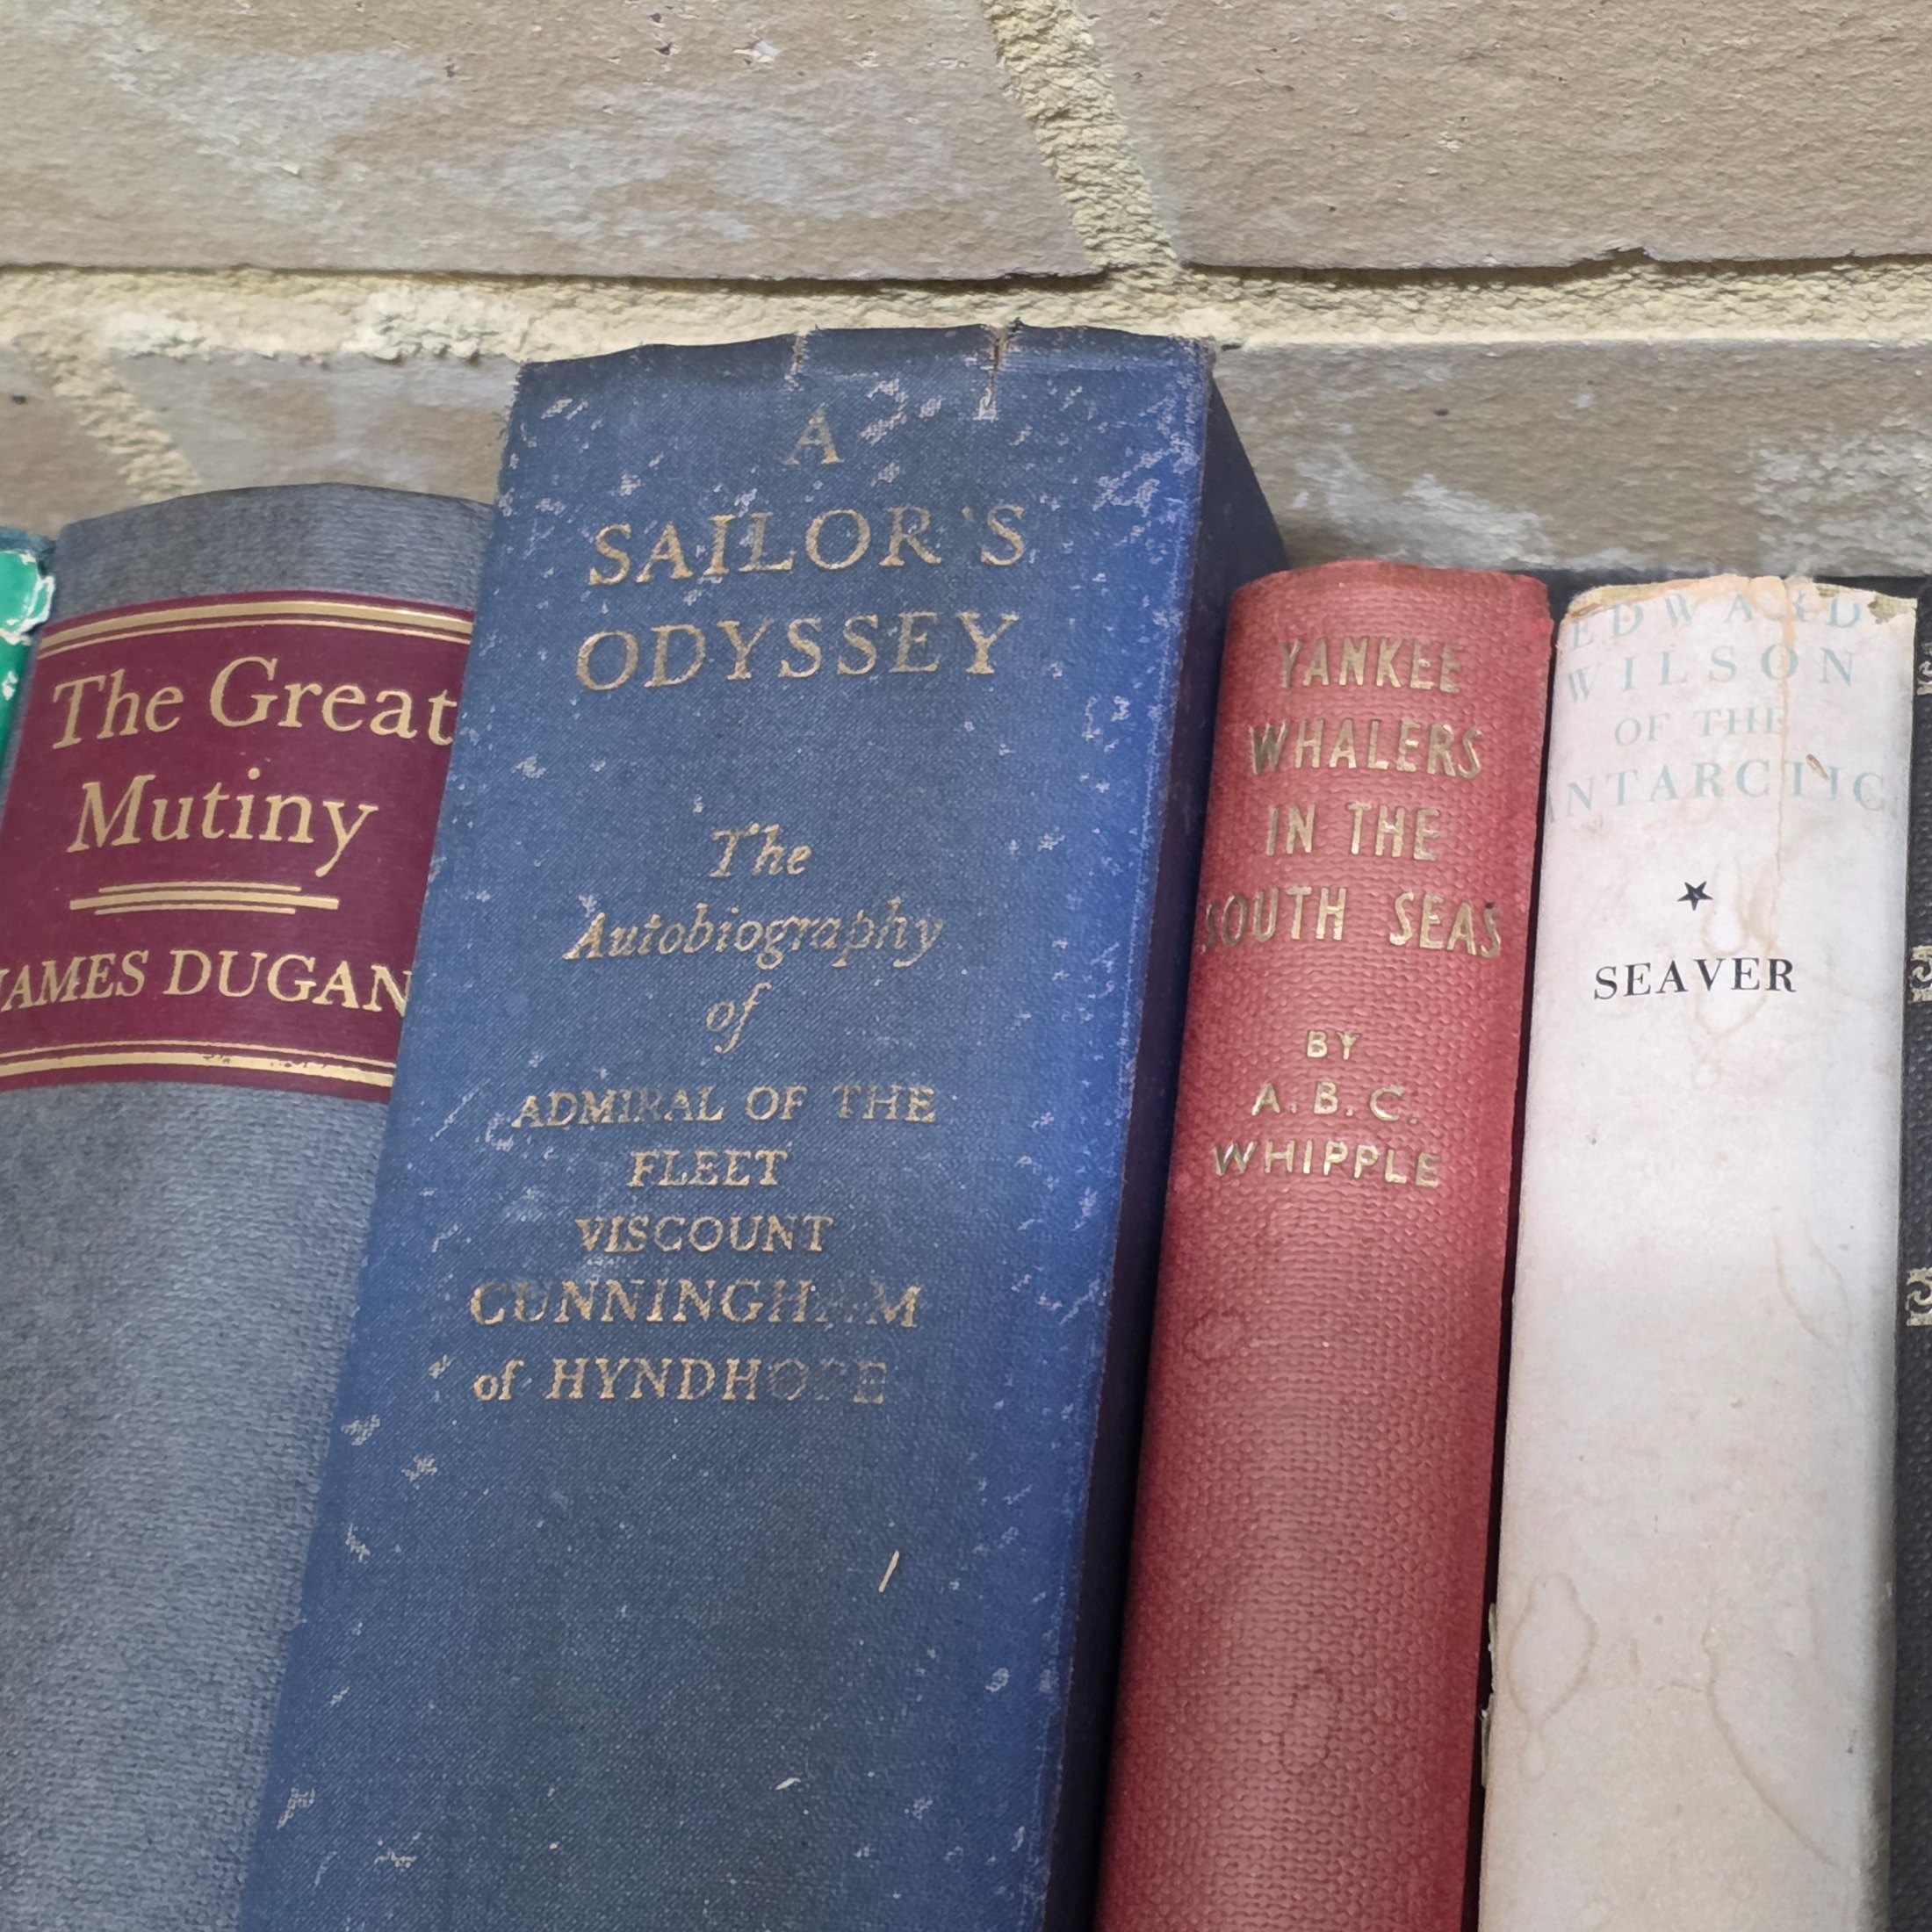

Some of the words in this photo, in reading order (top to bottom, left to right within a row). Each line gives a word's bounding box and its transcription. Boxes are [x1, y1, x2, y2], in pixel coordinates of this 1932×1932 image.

[783, 407, 844, 466] A
[588, 504, 1026, 586] SAILOR'S
[575, 611, 1020, 691] ODYSSEY
[1281, 637, 1465, 694] YANKEE
[1566, 643, 1856, 703] WILSON
[51, 668, 184, 749] The
[209, 655, 458, 746] Great
[1613, 713, 1672, 747] OF
[1692, 707, 1783, 738] THE
[1250, 717, 1484, 781] WHALERS
[66, 767, 379, 877] Mutiny
[710, 822, 813, 878] The
[1265, 804, 1316, 857] IN
[1347, 800, 1441, 862] THE
[562, 894, 943, 970] Autobiography
[1200, 885, 1348, 954] SOUTH
[1388, 890, 1503, 960] SEAS
[162, 949, 413, 1017] DUGAN
[1593, 957, 1797, 1001] SEAVER
[706, 981, 772, 1054] of
[1306, 1029, 1360, 1061] BY
[510, 1085, 724, 1128] ADMIRAL
[745, 1085, 808, 1123] OF
[832, 1085, 937, 1124] THE
[626, 1149, 789, 1187] FLEET
[1213, 1139, 1441, 1189] WHIPPLE
[575, 1215, 834, 1253] VISCOUNT
[472, 1359, 524, 1402] of
